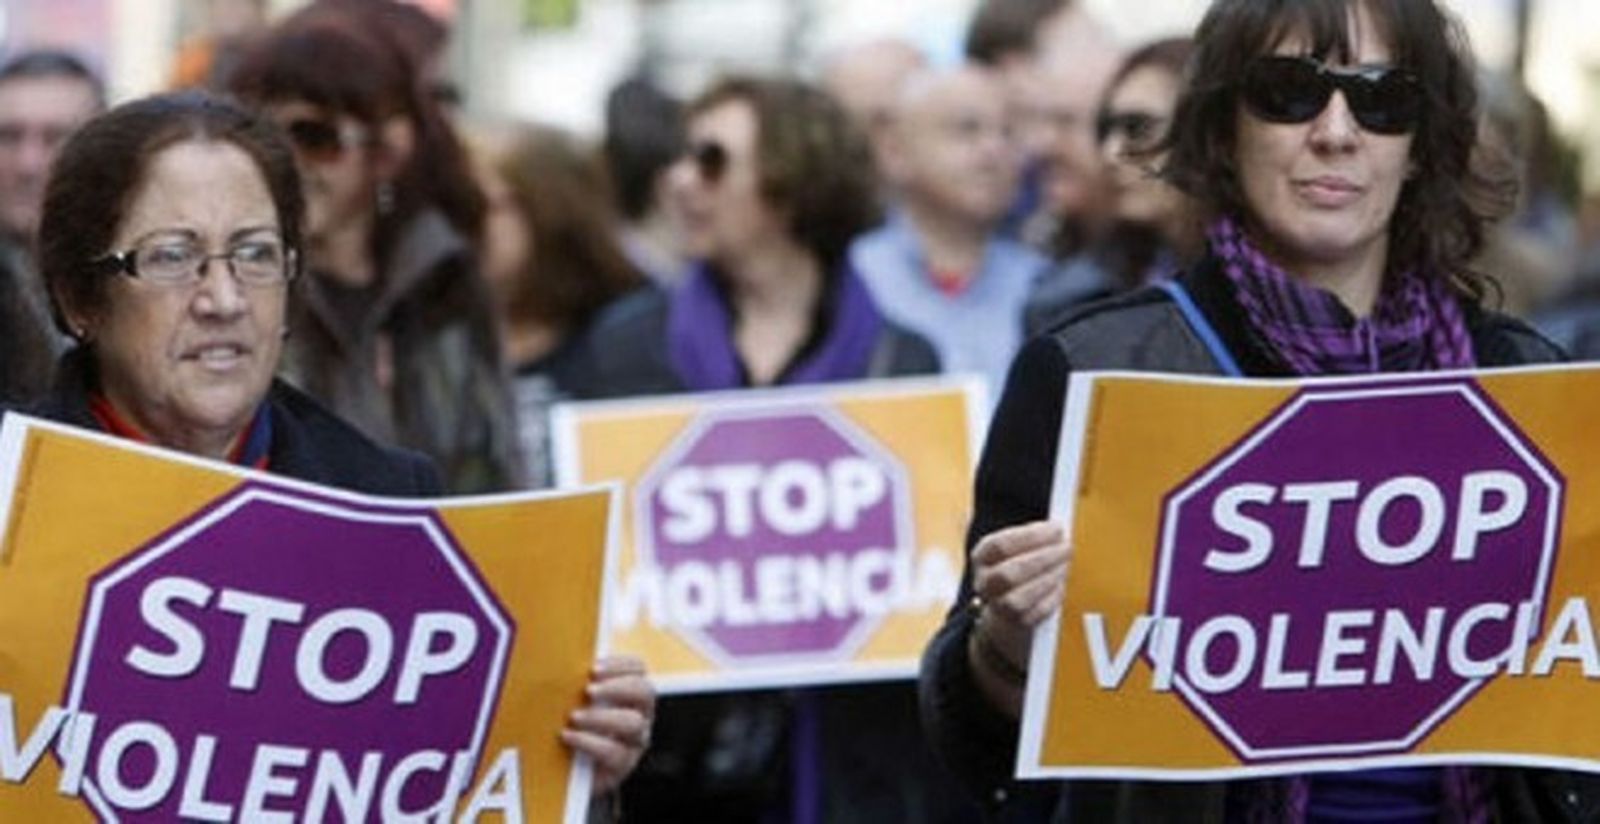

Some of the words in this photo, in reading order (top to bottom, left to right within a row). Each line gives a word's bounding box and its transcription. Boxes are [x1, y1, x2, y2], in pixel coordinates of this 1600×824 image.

[657, 456, 887, 543] STOP
[1204, 470, 1528, 572] STOP
[125, 576, 478, 703] STOP
[1083, 597, 1600, 693] VIOLENCIA
[0, 693, 524, 824] VIOLENCIA
